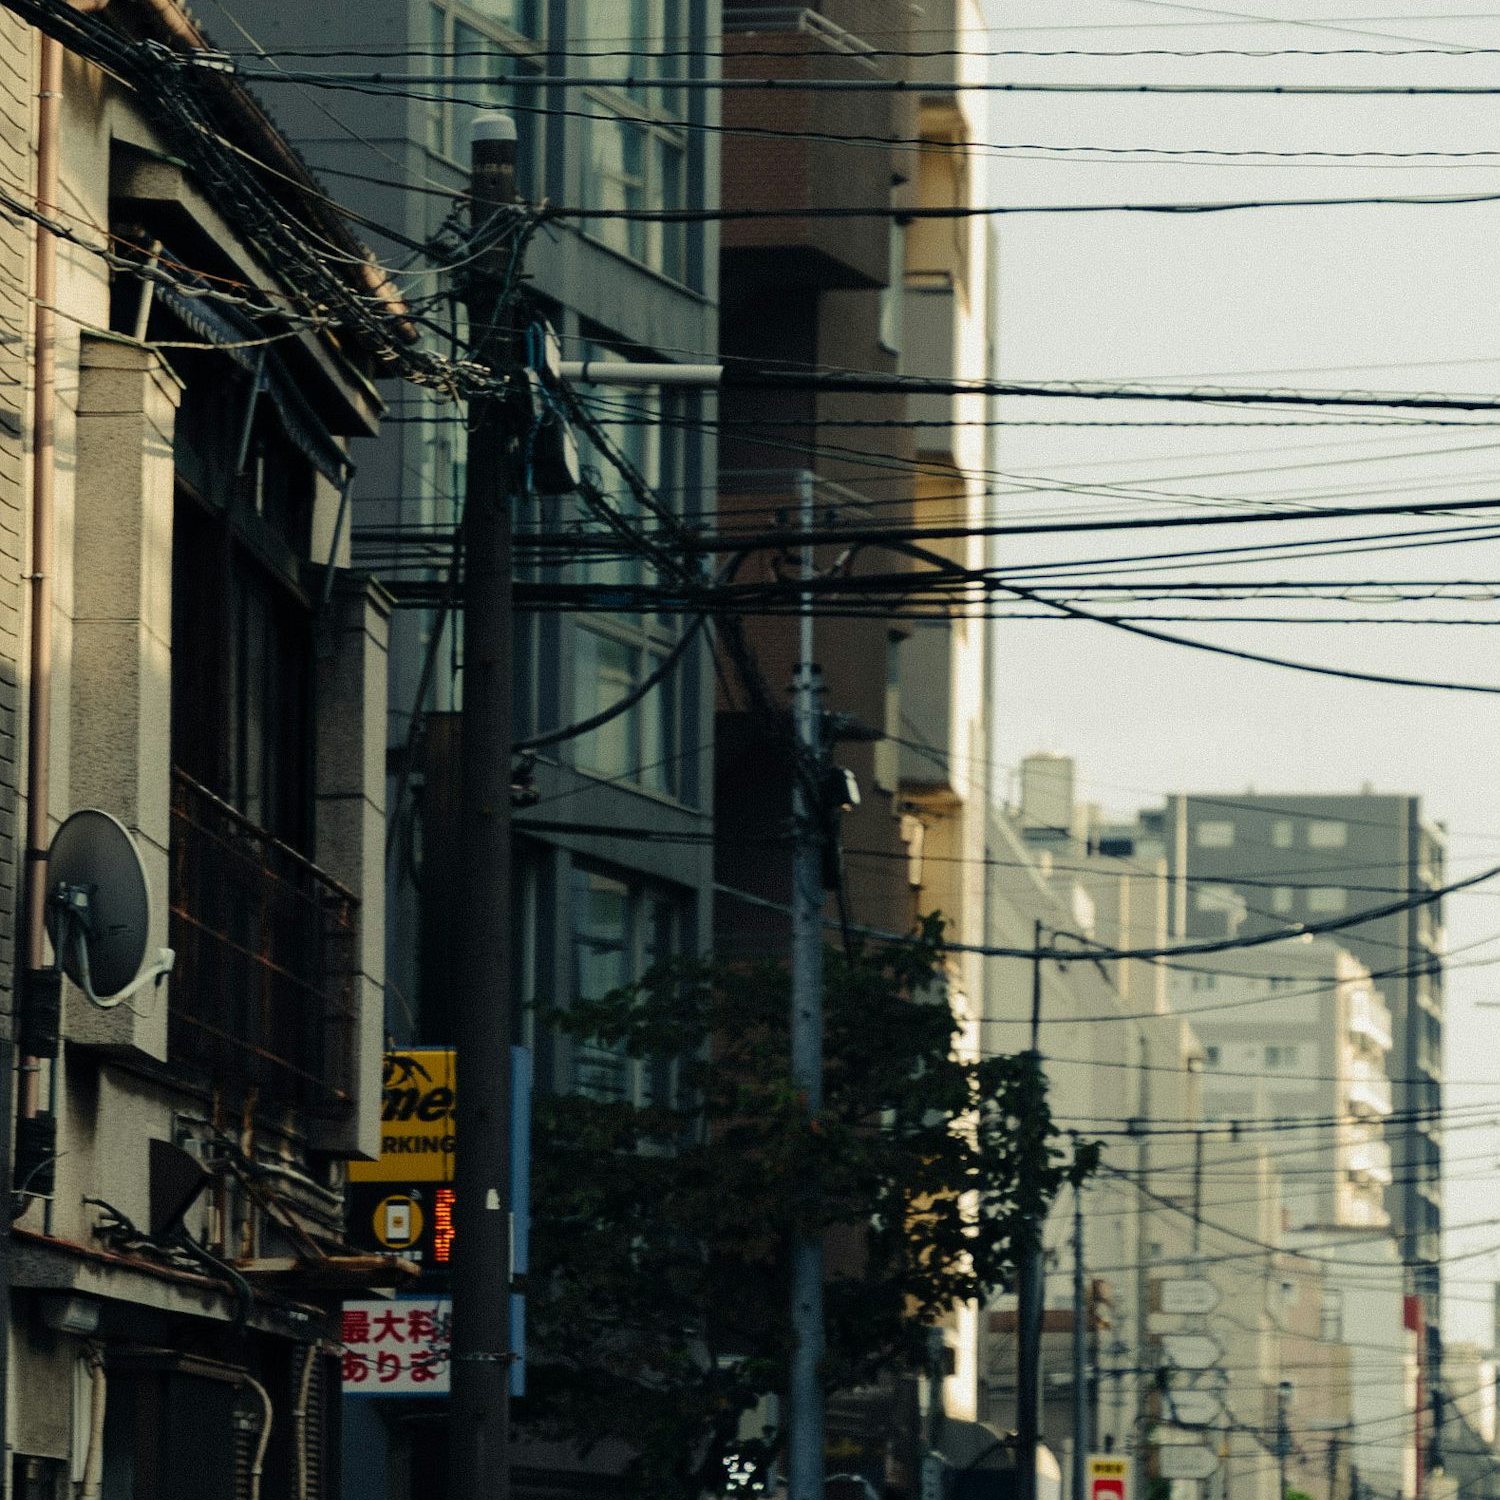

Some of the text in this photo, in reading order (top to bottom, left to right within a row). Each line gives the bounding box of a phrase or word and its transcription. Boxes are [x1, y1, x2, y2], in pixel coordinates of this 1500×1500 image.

[382, 1086, 456, 1121] me
[383, 1136, 456, 1153] RKING
[341, 1310, 453, 1343] 最大料
[341, 1351, 450, 1383] ありま
